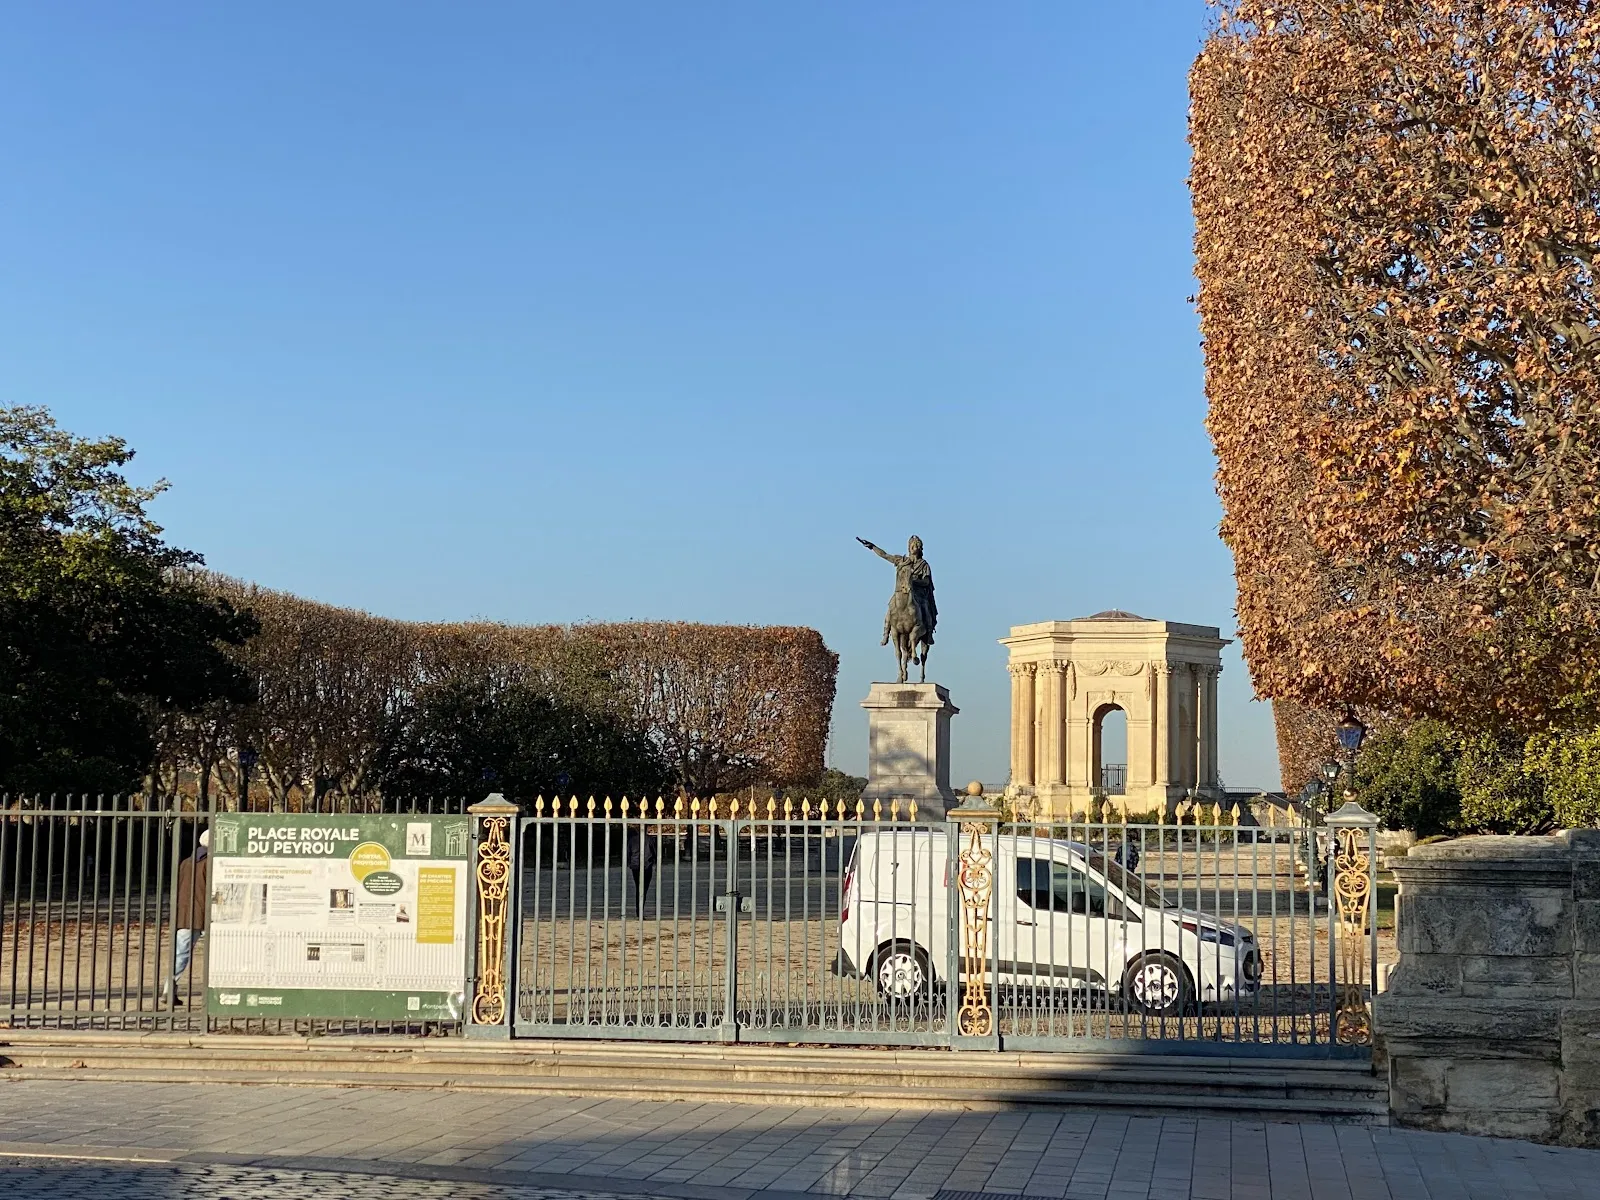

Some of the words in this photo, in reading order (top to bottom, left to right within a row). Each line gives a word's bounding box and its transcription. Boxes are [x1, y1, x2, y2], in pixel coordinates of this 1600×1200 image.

[248, 827, 297, 840] PLACE
[300, 827, 360, 841] ROYALE
[411, 833, 426, 847] M
[247, 841, 270, 854] DU
[273, 841, 335, 854] PEYROU
